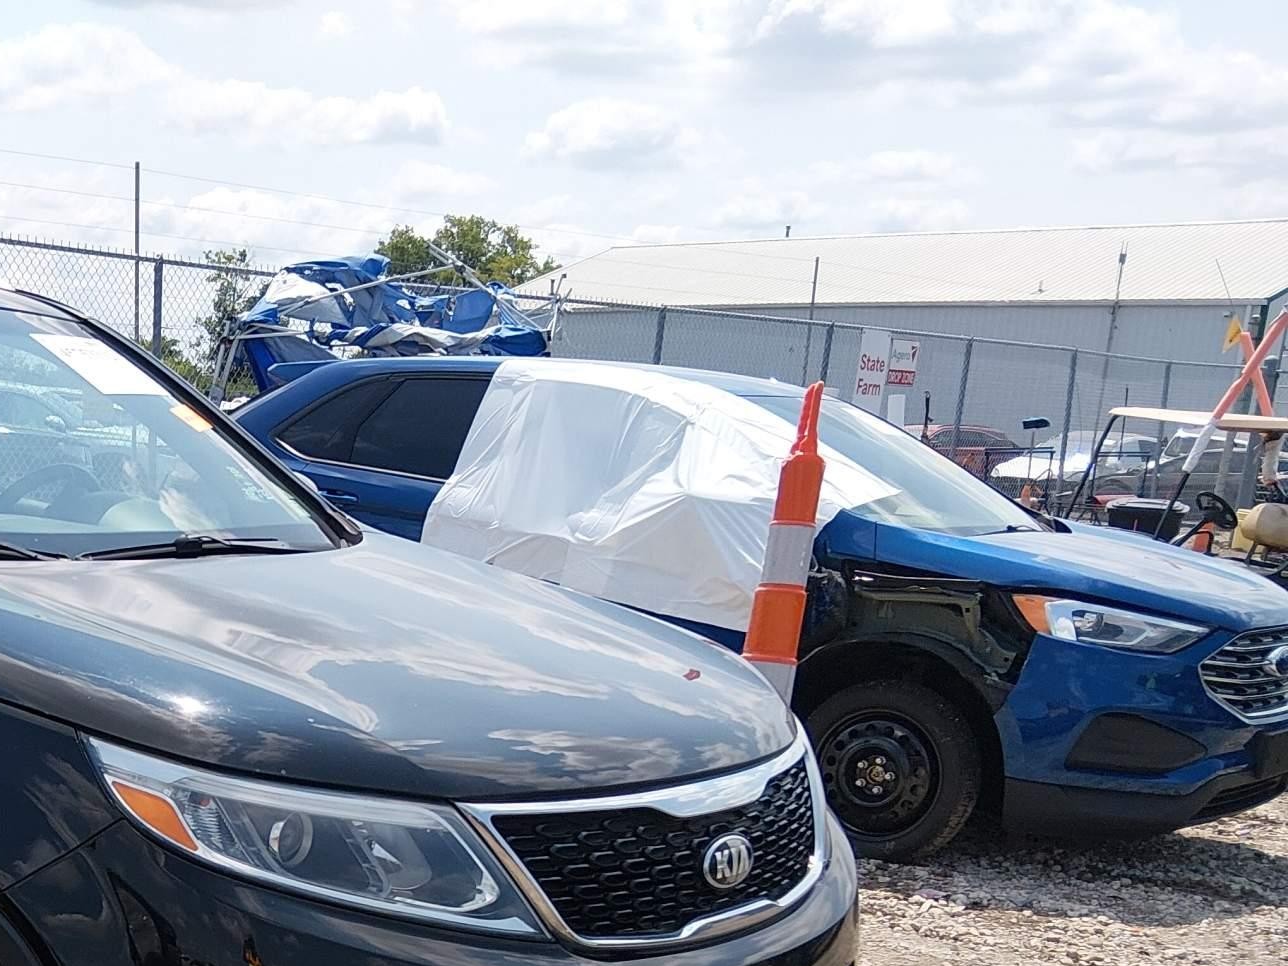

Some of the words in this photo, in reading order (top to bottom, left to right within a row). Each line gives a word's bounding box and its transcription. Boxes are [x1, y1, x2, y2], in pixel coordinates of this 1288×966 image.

[860, 353, 885, 373] State
[888, 371, 902, 383] DROP
[856, 378, 881, 397] Farm
[715, 845, 749, 879] KIA
